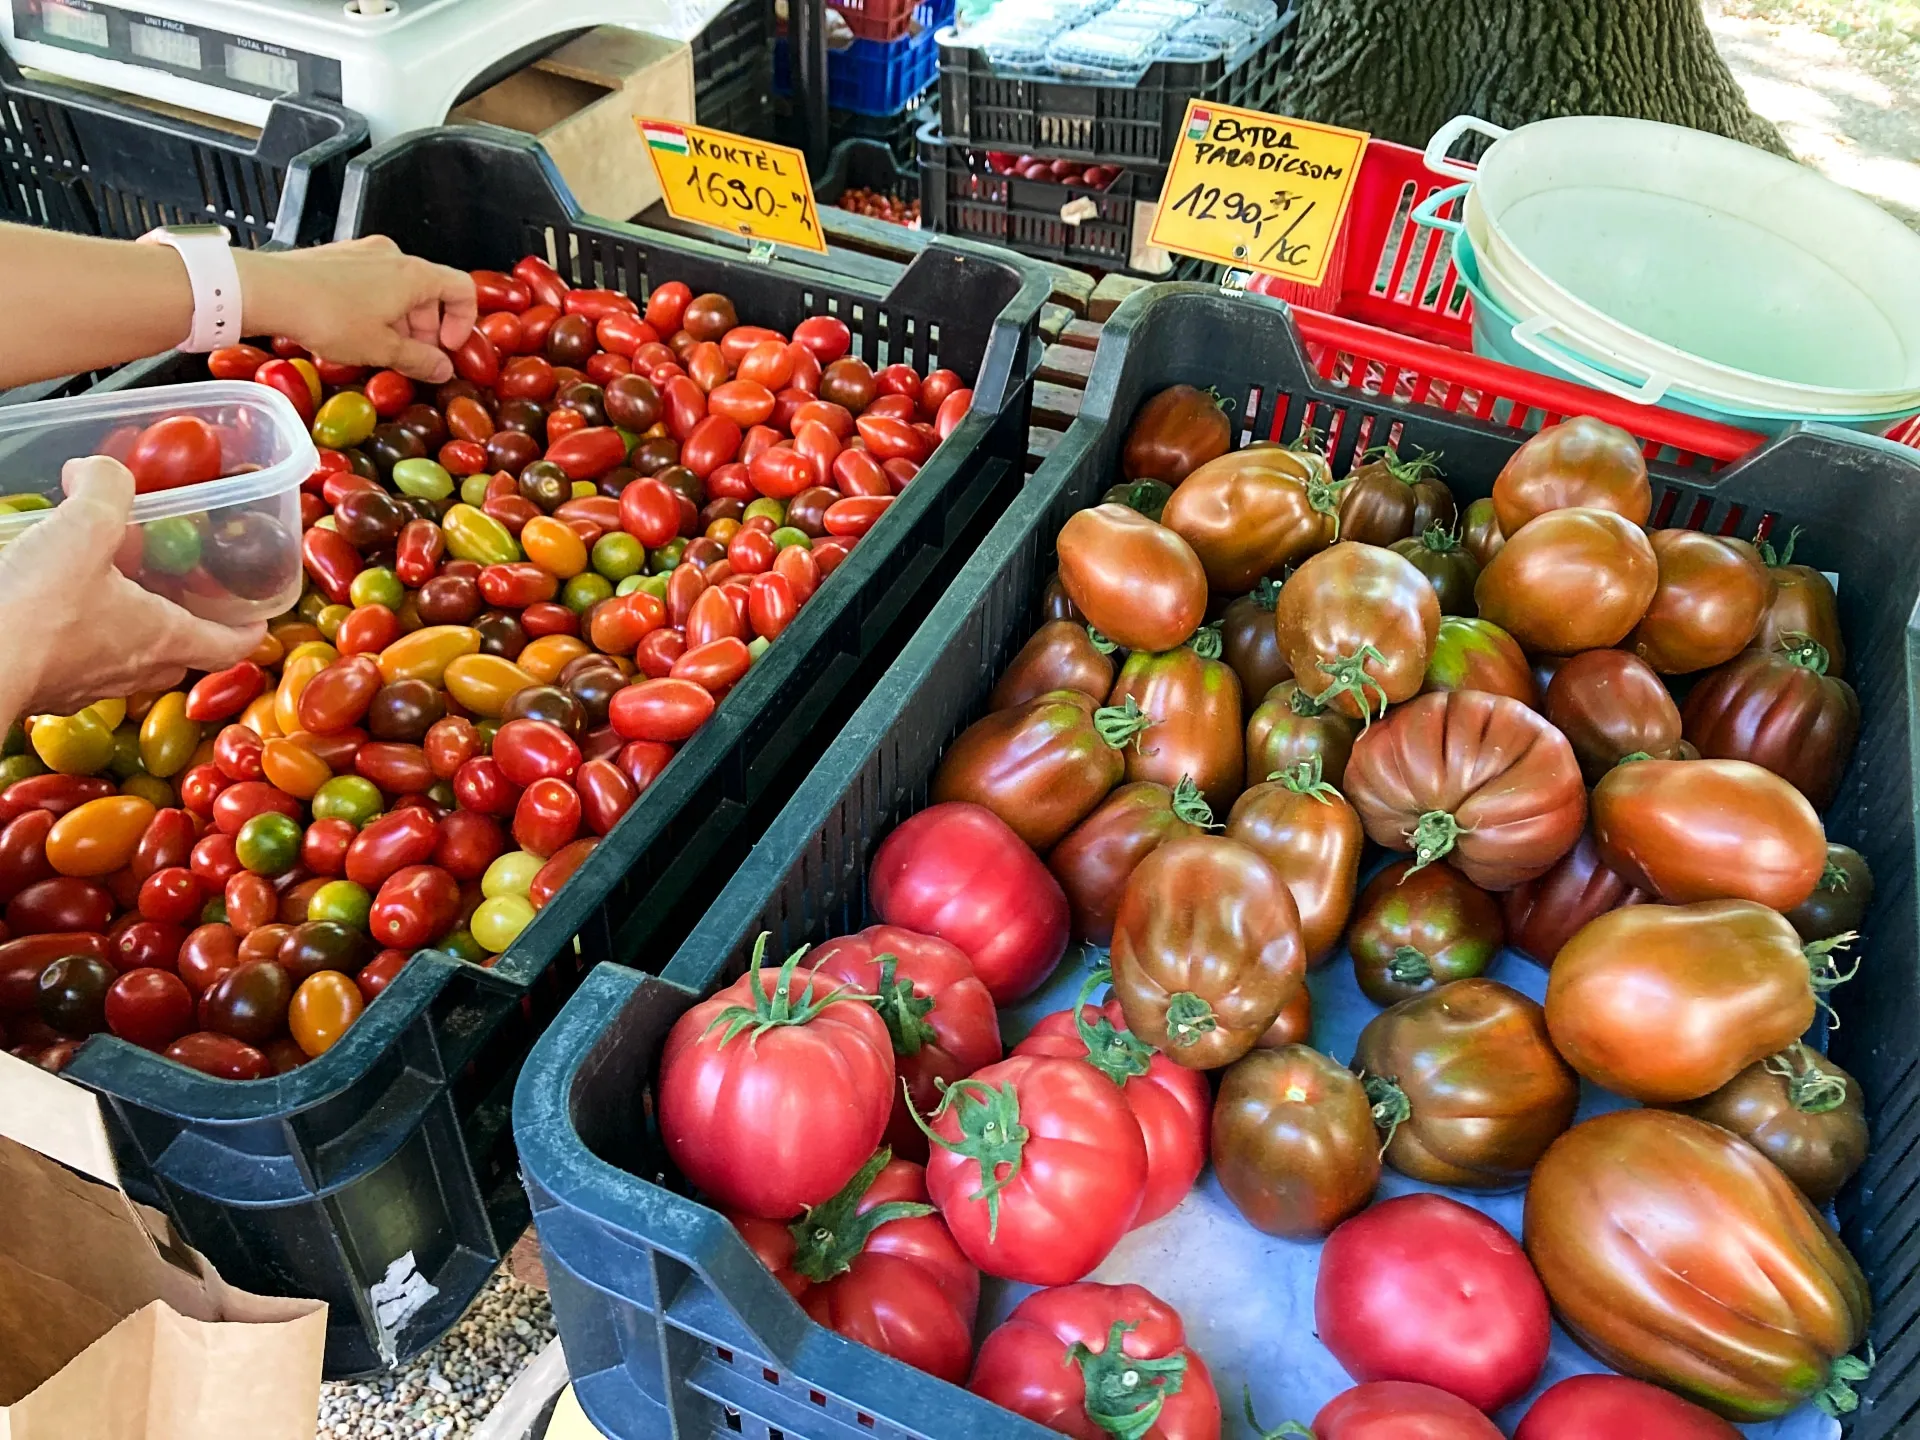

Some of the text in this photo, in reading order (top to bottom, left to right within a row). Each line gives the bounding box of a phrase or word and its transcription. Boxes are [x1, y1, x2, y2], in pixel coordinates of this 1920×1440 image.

[145, 16, 185, 32] UNIT PRICE
[237, 37, 287, 57] TOTAL PRICE
[1213, 119, 1299, 149] EXTRA
